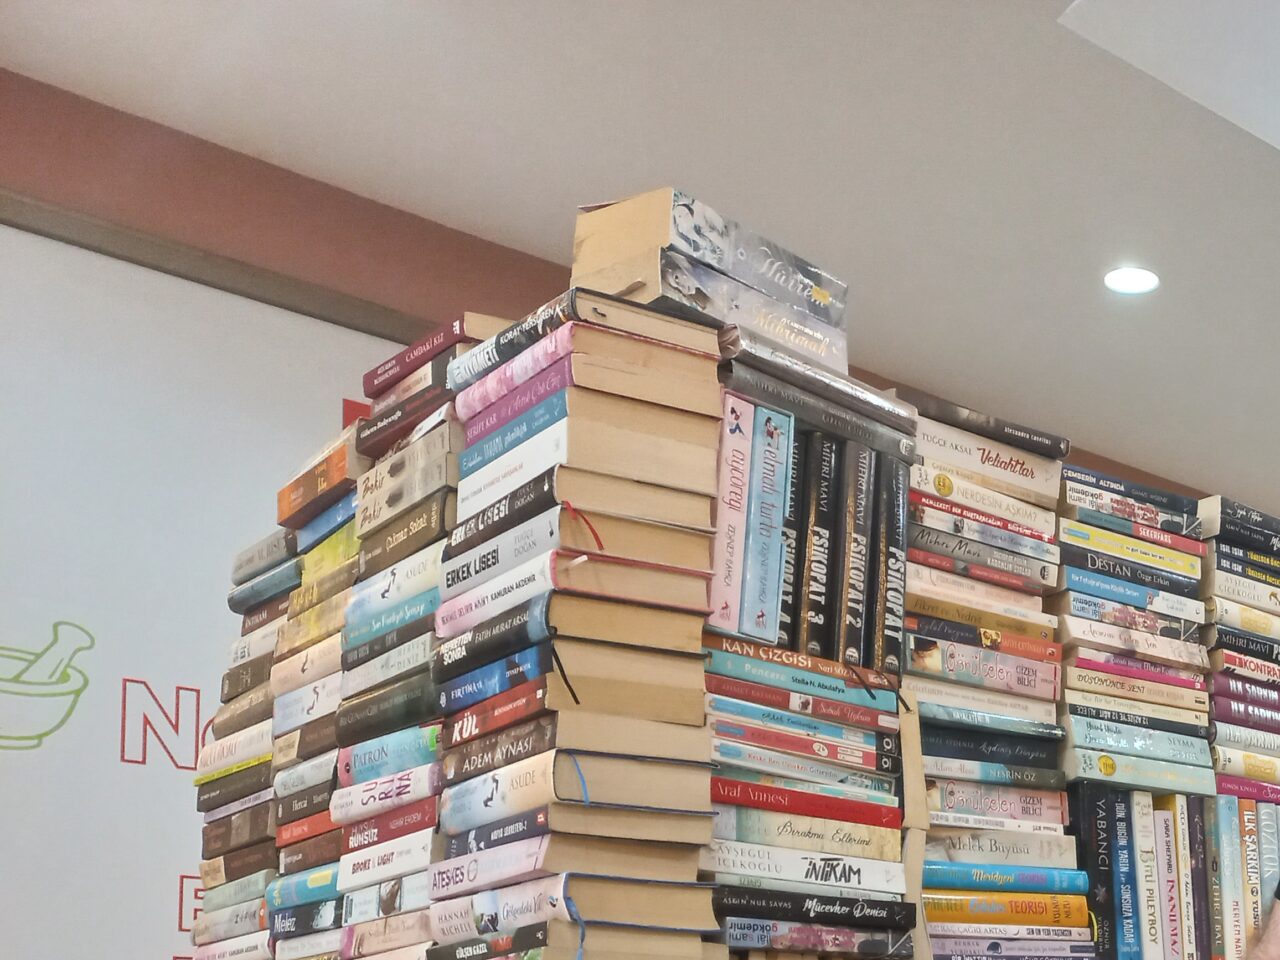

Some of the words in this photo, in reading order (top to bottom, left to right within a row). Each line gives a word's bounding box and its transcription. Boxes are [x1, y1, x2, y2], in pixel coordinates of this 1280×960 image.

[445, 559, 476, 590] ERKEK
[474, 545, 501, 574] LİSESİ
[809, 526, 830, 605] PSİKOPAT
[846, 533, 867, 611] PSİKOPAT
[1087, 553, 1131, 578] DESTAN
[885, 546, 907, 642] PSİKOPAT
[808, 609, 825, 625] 3
[845, 614, 863, 628] 2
[443, 645, 468, 666] SONRA
[722, 638, 755, 657] KAN
[759, 646, 812, 669] ÇİZGİSİ
[1248, 640, 1270, 655] MAVİ
[452, 711, 480, 745] KÜL
[352, 744, 390, 769] PATRON
[463, 752, 493, 773] ADEM
[493, 735, 533, 765] AYNASI
[1115, 802, 1126, 820] DÜN
[349, 829, 379, 849] RUHSUZ
[1096, 799, 1109, 871] YABANCI
[1116, 821, 1128, 847] BUGÜN
[948, 836, 985, 854] Melek
[989, 838, 1031, 860] Büyüsü
[1118, 848, 1131, 873] YARIN
[1244, 828, 1259, 887] ŞARKIM
[352, 858, 372, 876] BROKE
[377, 851, 395, 867] LIGHT
[432, 864, 466, 893] ATEŞKES
[802, 898, 851, 919] Mücevher
[853, 898, 889, 918] Denizi
[1120, 885, 1134, 918] SONSUZA
[274, 912, 297, 933] Melez
[728, 920, 779, 933] gökdemir
[1123, 919, 1136, 944] KADAR
[1214, 923, 1223, 946] BAL
